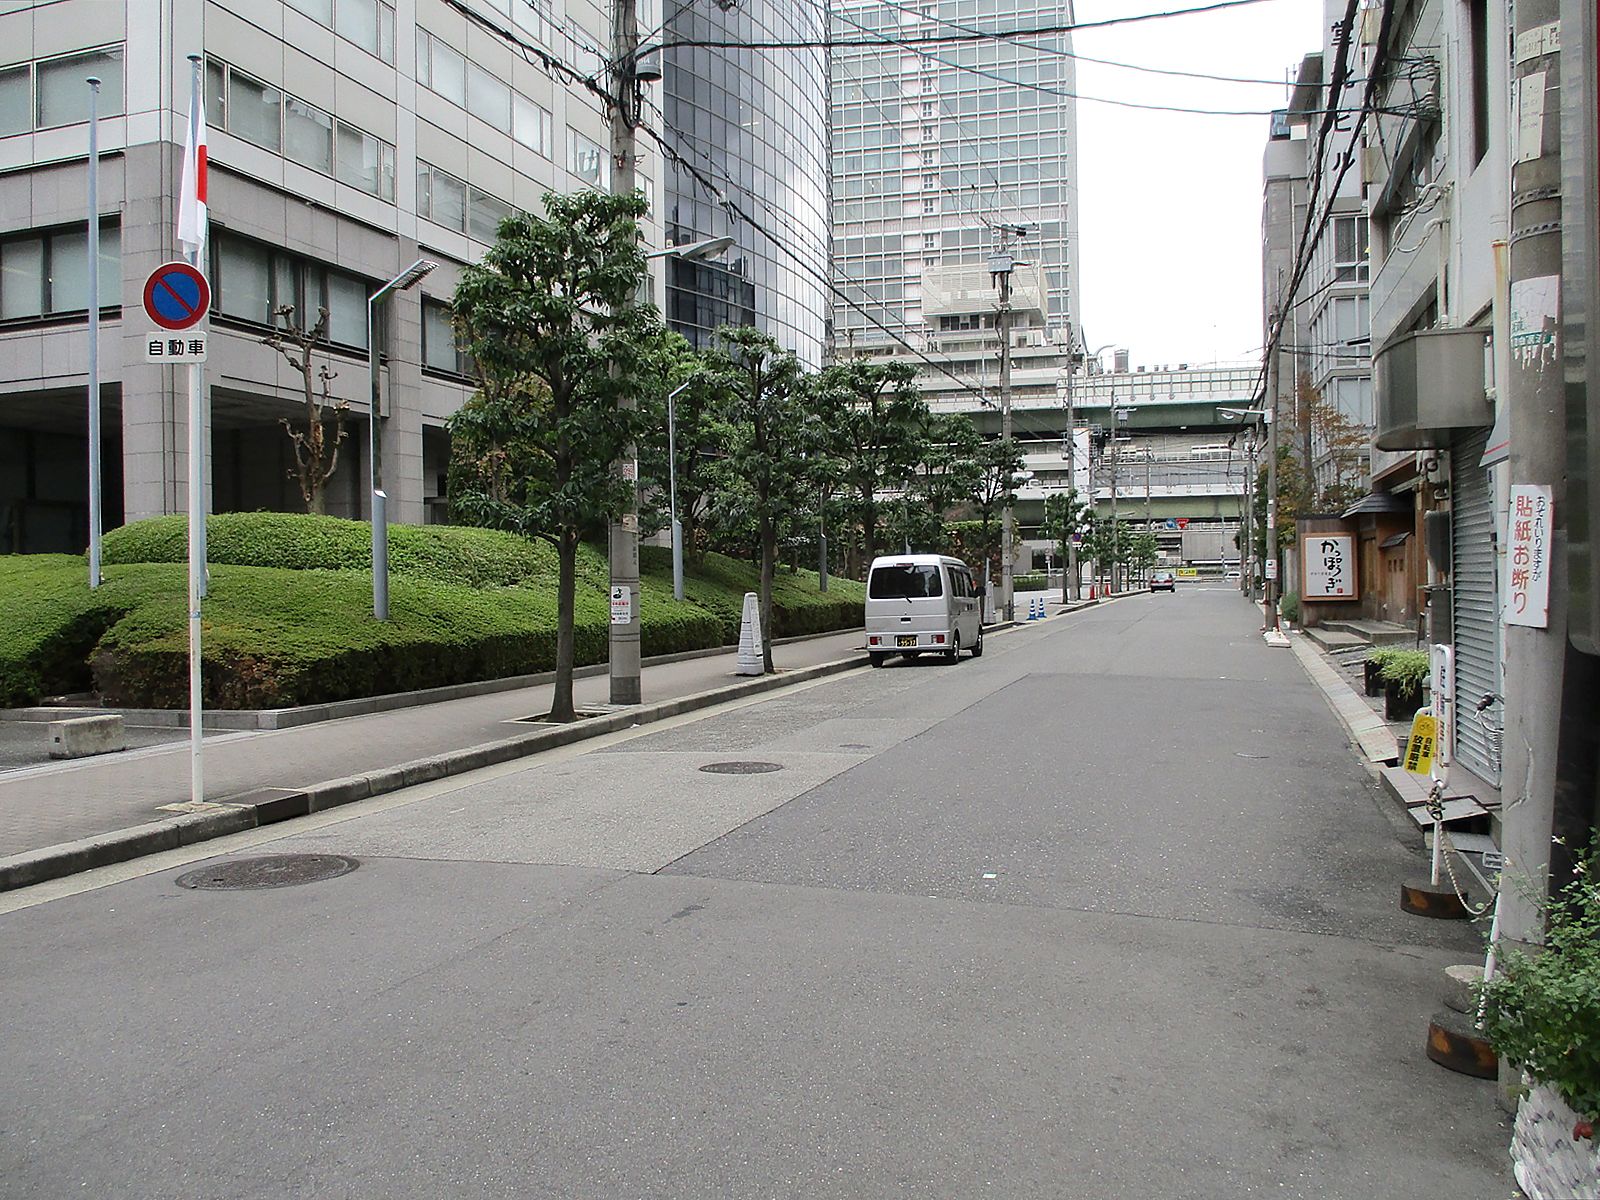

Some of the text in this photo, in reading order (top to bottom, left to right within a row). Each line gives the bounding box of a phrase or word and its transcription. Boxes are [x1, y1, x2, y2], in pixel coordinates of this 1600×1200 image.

[149, 339, 204, 356] 自動車
[1321, 539, 1343, 593] かっぽうぎ
[1511, 495, 1533, 615] 貼紙お断り
[1532, 495, 1546, 583] おそれいりますが
